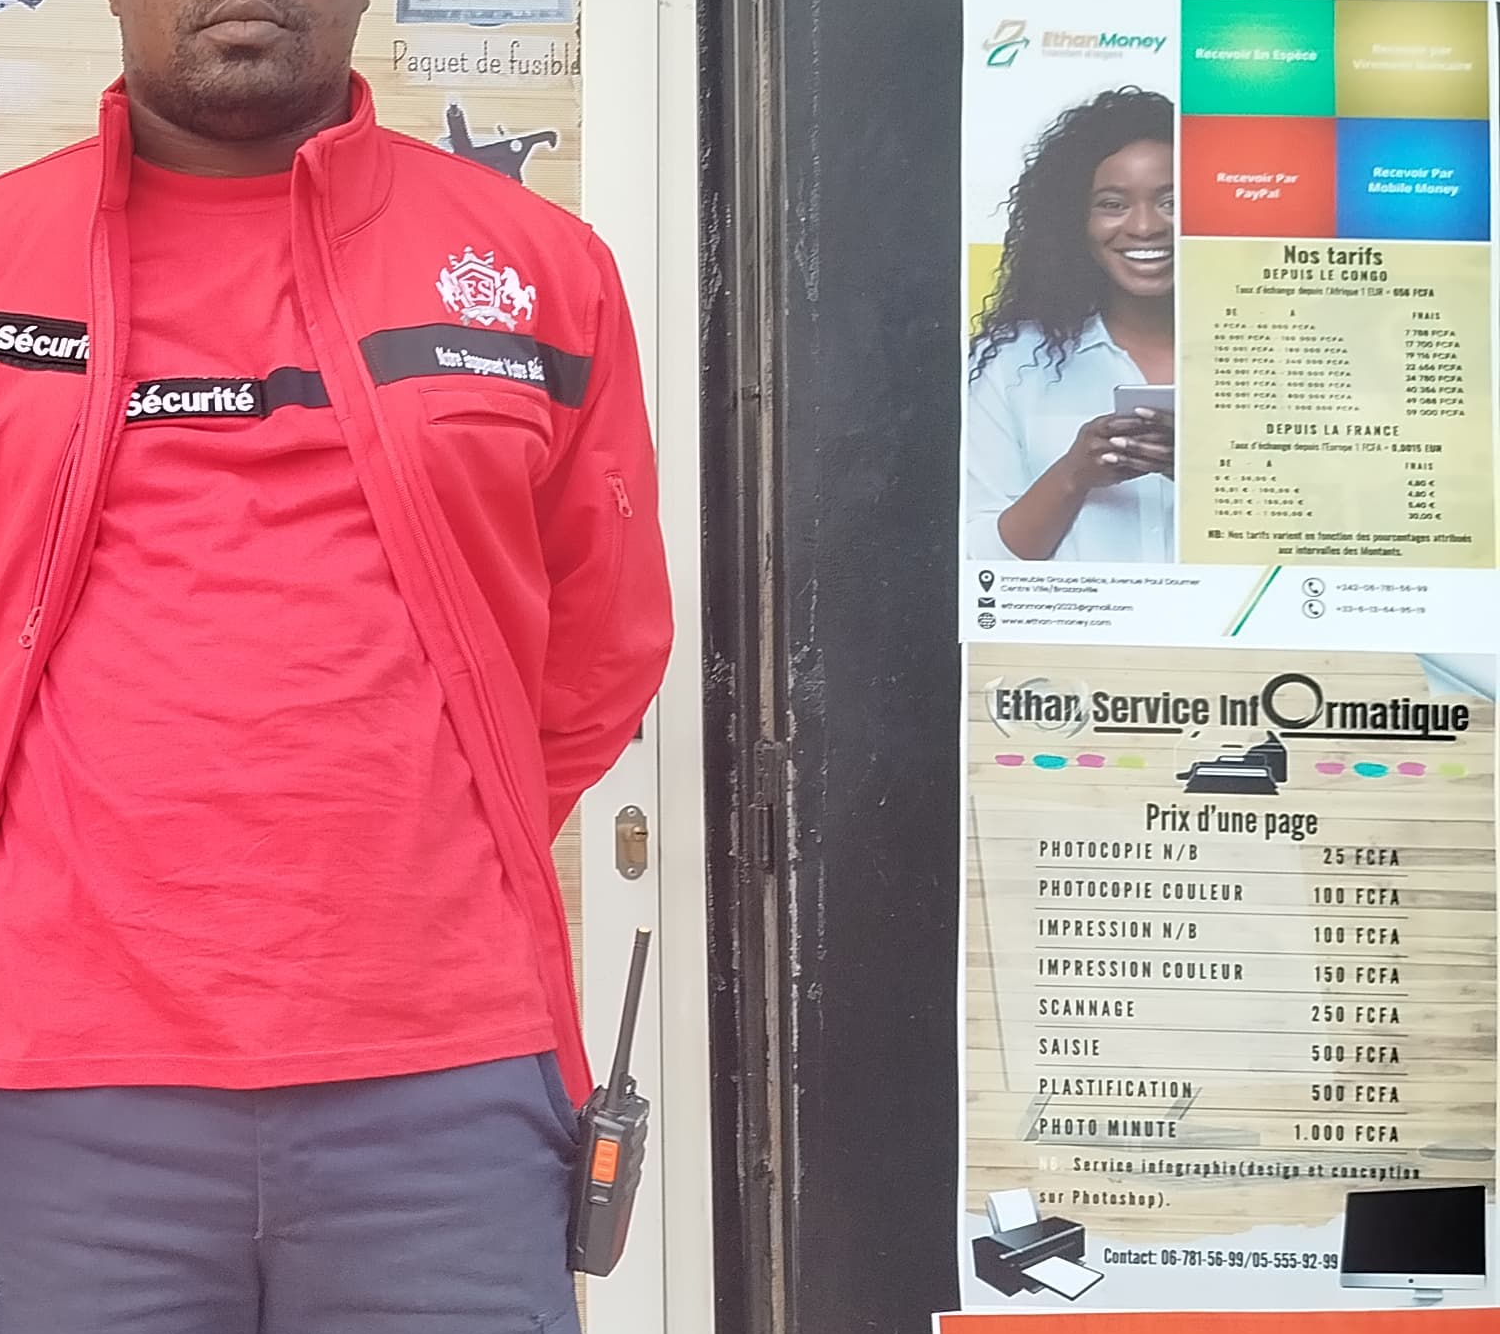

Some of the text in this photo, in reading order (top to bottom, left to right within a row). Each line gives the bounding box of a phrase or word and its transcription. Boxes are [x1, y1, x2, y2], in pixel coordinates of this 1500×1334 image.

[393, 40, 468, 80] Paquet
[476, 40, 501, 74] de
[1284, 245, 1383, 266] Nos tarifs
[1263, 268, 1388, 282] DEPUIS LE CONGO
[1266, 423, 1400, 436] DEPUIS LA FRANCE
[996, 687, 1081, 724] Ethan
[1092, 690, 1210, 727] Service
[1146, 803, 1318, 840] Prix d'une page
[1039, 841, 1199, 862] PHOTOCOPIE N/B
[1323, 848, 1400, 867] 25 FCFA
[1039, 880, 1243, 902] PHOTOCOPIE COULEUR
[1313, 887, 1400, 906] 100 FCFA
[1039, 919, 1198, 941] IMPRESSION N/B
[1313, 927, 1400, 946] 100 FCFA
[1039, 959, 1243, 981] IMPRESSION COULEUR
[1314, 966, 1400, 985] 150 FCFA
[1039, 999, 1135, 1018] SCANNAGE
[1311, 1005, 1400, 1025] 250 FCFA
[1039, 1039, 1101, 1057] SAISIE
[1311, 1045, 1400, 1064] 500 FCFA
[1039, 1079, 1193, 1099] PLASTIFICATION
[1311, 1085, 1400, 1104] 500 FCFA
[1039, 1118, 1177, 1139] PHOTO MINUTE
[1354, 1125, 1400, 1144] FCFA
